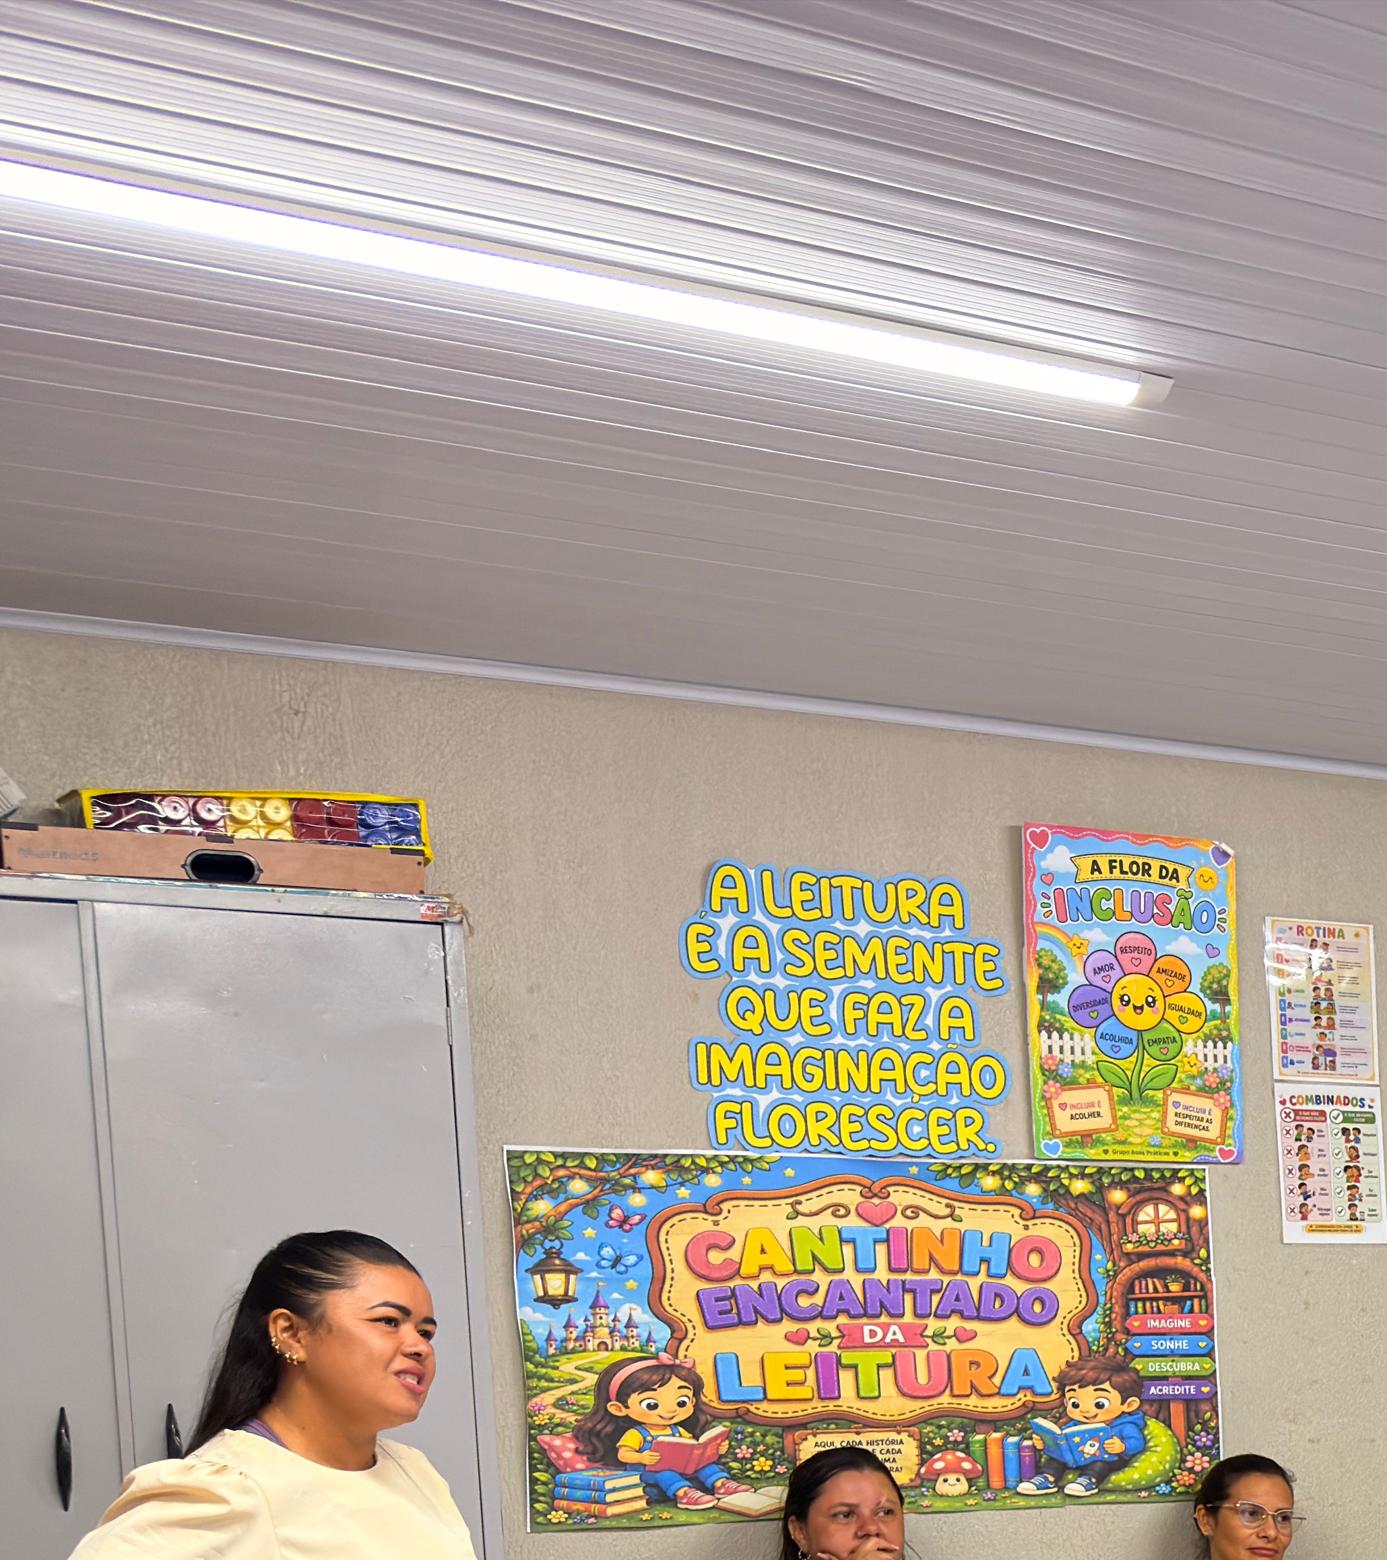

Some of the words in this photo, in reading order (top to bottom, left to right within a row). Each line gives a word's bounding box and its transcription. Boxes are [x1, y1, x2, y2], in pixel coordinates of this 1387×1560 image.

[1090, 860, 1100, 876] A
[1108, 859, 1152, 878] FLOR
[1158, 864, 1180, 884] DA
[710, 864, 749, 915] A
[761, 868, 965, 930] LEITURA
[1053, 887, 1217, 935] INCLUSÃO
[1296, 924, 1345, 940] ROTINA
[685, 911, 720, 974] É
[731, 924, 771, 973] A
[781, 927, 1004, 991] SEMENTE
[1119, 945, 1153, 957] RESPEITO
[1092, 962, 1116, 977] AMOR
[1156, 966, 1187, 982] AMIZADE
[725, 985, 832, 1036] QUE
[844, 991, 928, 1041] FAZ
[938, 996, 976, 1041] A
[1167, 1002, 1203, 1020] IGUALDADE
[1099, 1031, 1134, 1046] ACOLHIDA
[1146, 1036, 1178, 1047] EMPATIA
[695, 1041, 1007, 1104] IMAGINAÇÃO
[1289, 1095, 1366, 1109] COMBINADOS
[1070, 1110, 1104, 1122] ACOLHER.
[1174, 1112, 1204, 1124] RESPEITAR
[714, 1100, 997, 1155] FLORESCER.
[685, 1225, 1063, 1283] CANTINHO
[696, 1278, 1060, 1330] ENCANTADO
[1147, 1318, 1192, 1329] IMAGINE
[862, 1324, 905, 1344] DA
[1151, 1339, 1189, 1350] SONHE
[714, 1347, 1054, 1401] LEITURA
[1148, 1362, 1201, 1372] DESCUBRA
[1149, 1385, 1197, 1395] ACREDITE
[866, 1438, 904, 1447] HISTÓRIA
[879, 1448, 902, 1456] CADA
